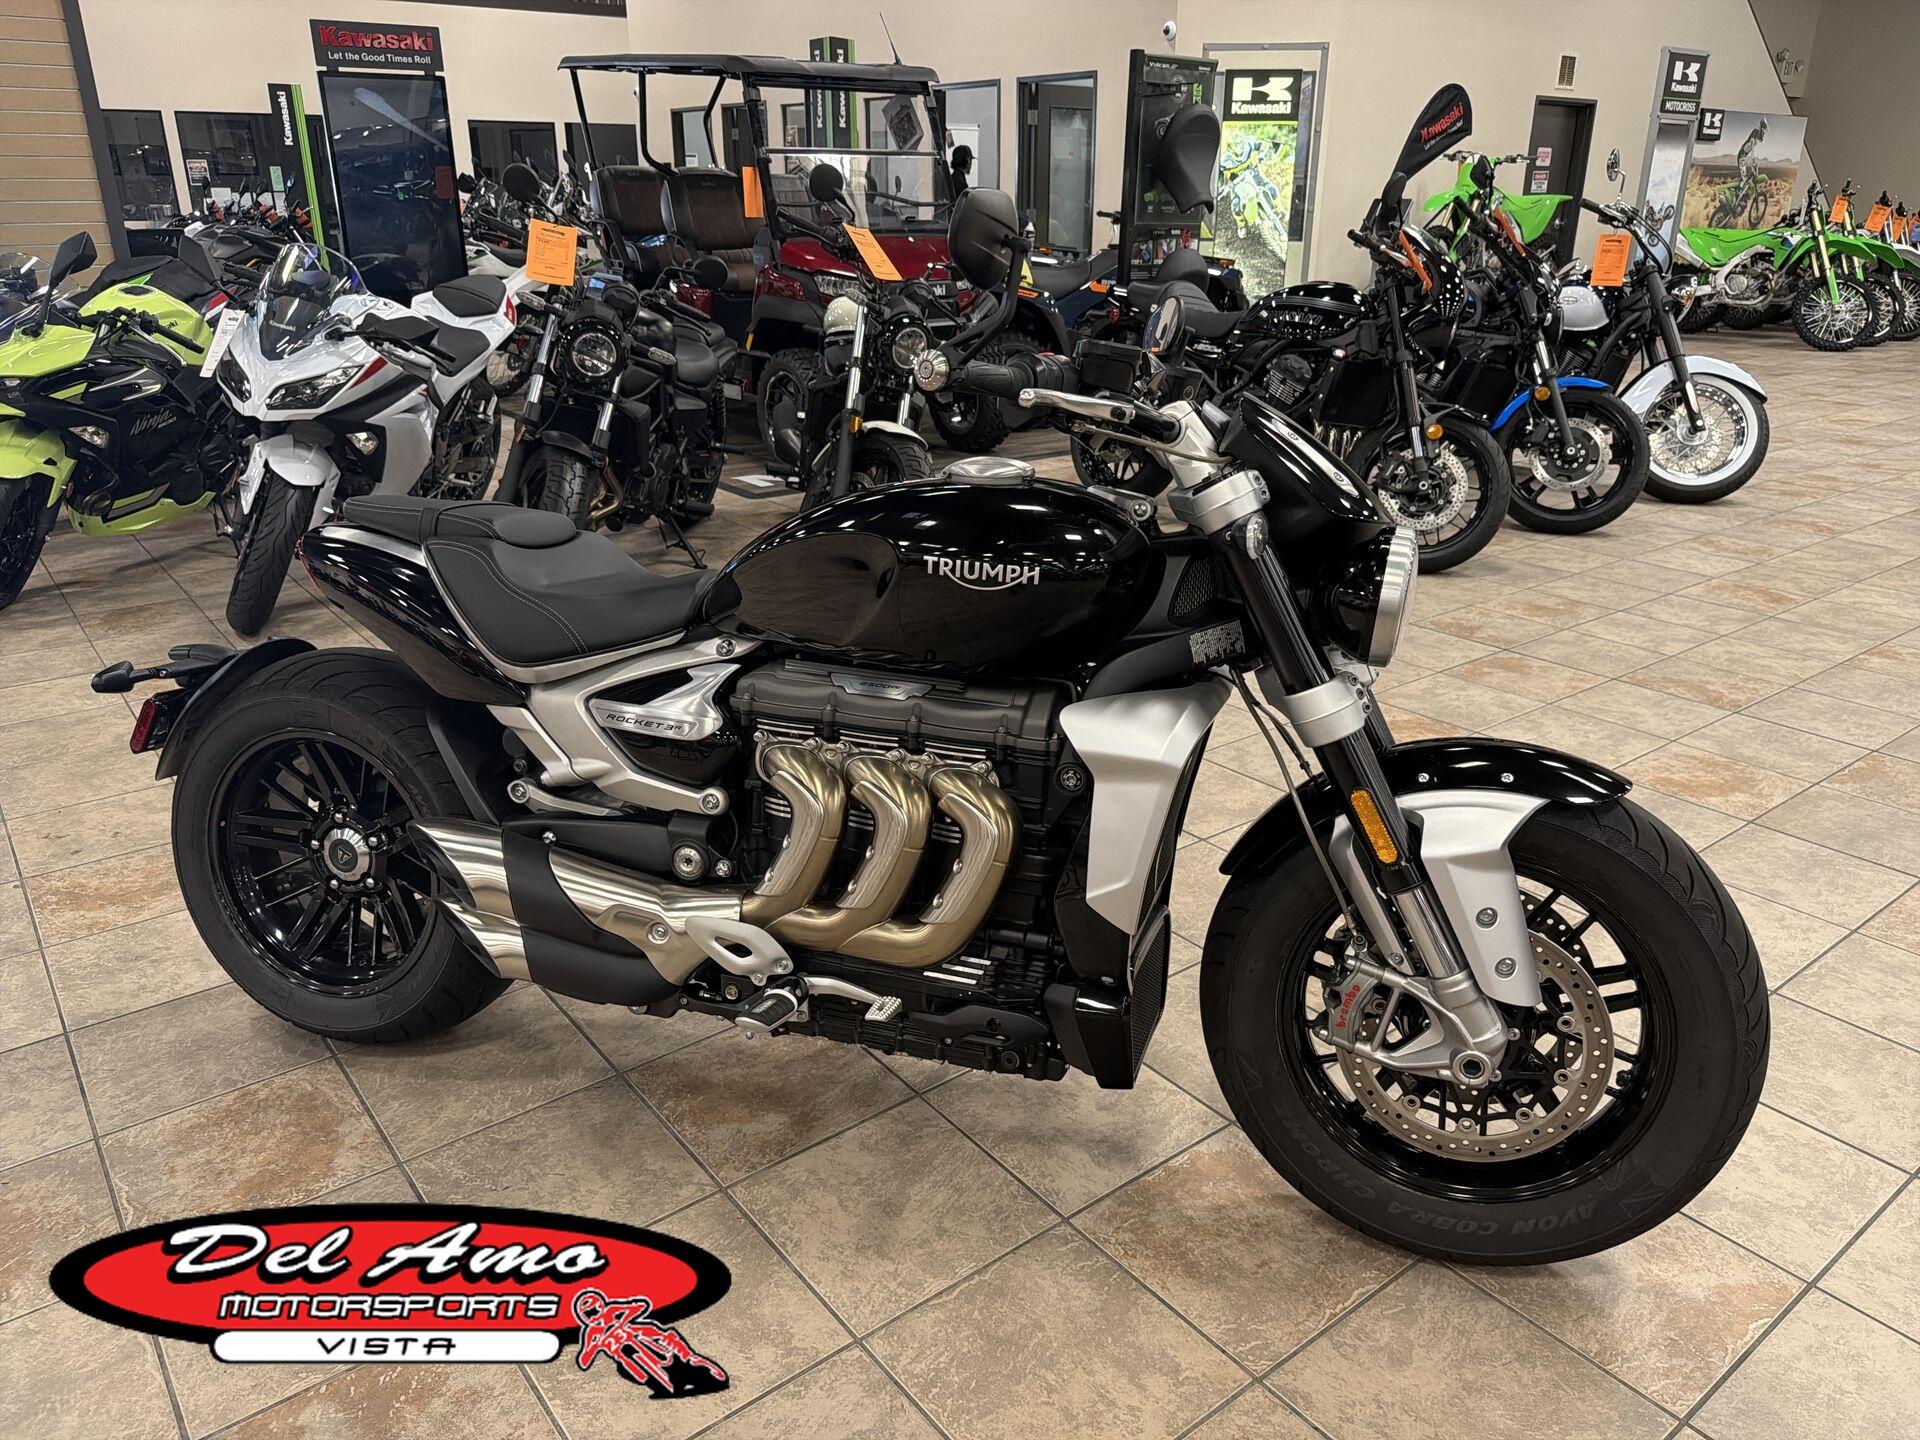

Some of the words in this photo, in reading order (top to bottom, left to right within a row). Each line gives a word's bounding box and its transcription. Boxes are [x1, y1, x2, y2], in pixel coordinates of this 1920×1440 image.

[319, 25, 433, 51] Kawasaki
[328, 51, 343, 60] Let
[345, 52, 360, 60] the
[361, 53, 385, 62] Good
[386, 54, 413, 63] Times
[414, 55, 431, 64] Roll
[1670, 81, 1698, 93] Kawasaki
[278, 91, 293, 145] Kawasaki
[1231, 102, 1291, 114] Kawasaki
[1664, 100, 1697, 112] MOTOCROSS
[1421, 103, 1463, 142] Kawasaki
[131, 409, 170, 435] Ninja
[923, 555, 1040, 590] TRIUMPH
[1335, 984, 1360, 1029] brembo
[1387, 1201, 1499, 1236] COBRA
[1510, 1201, 1598, 1235] AVON
